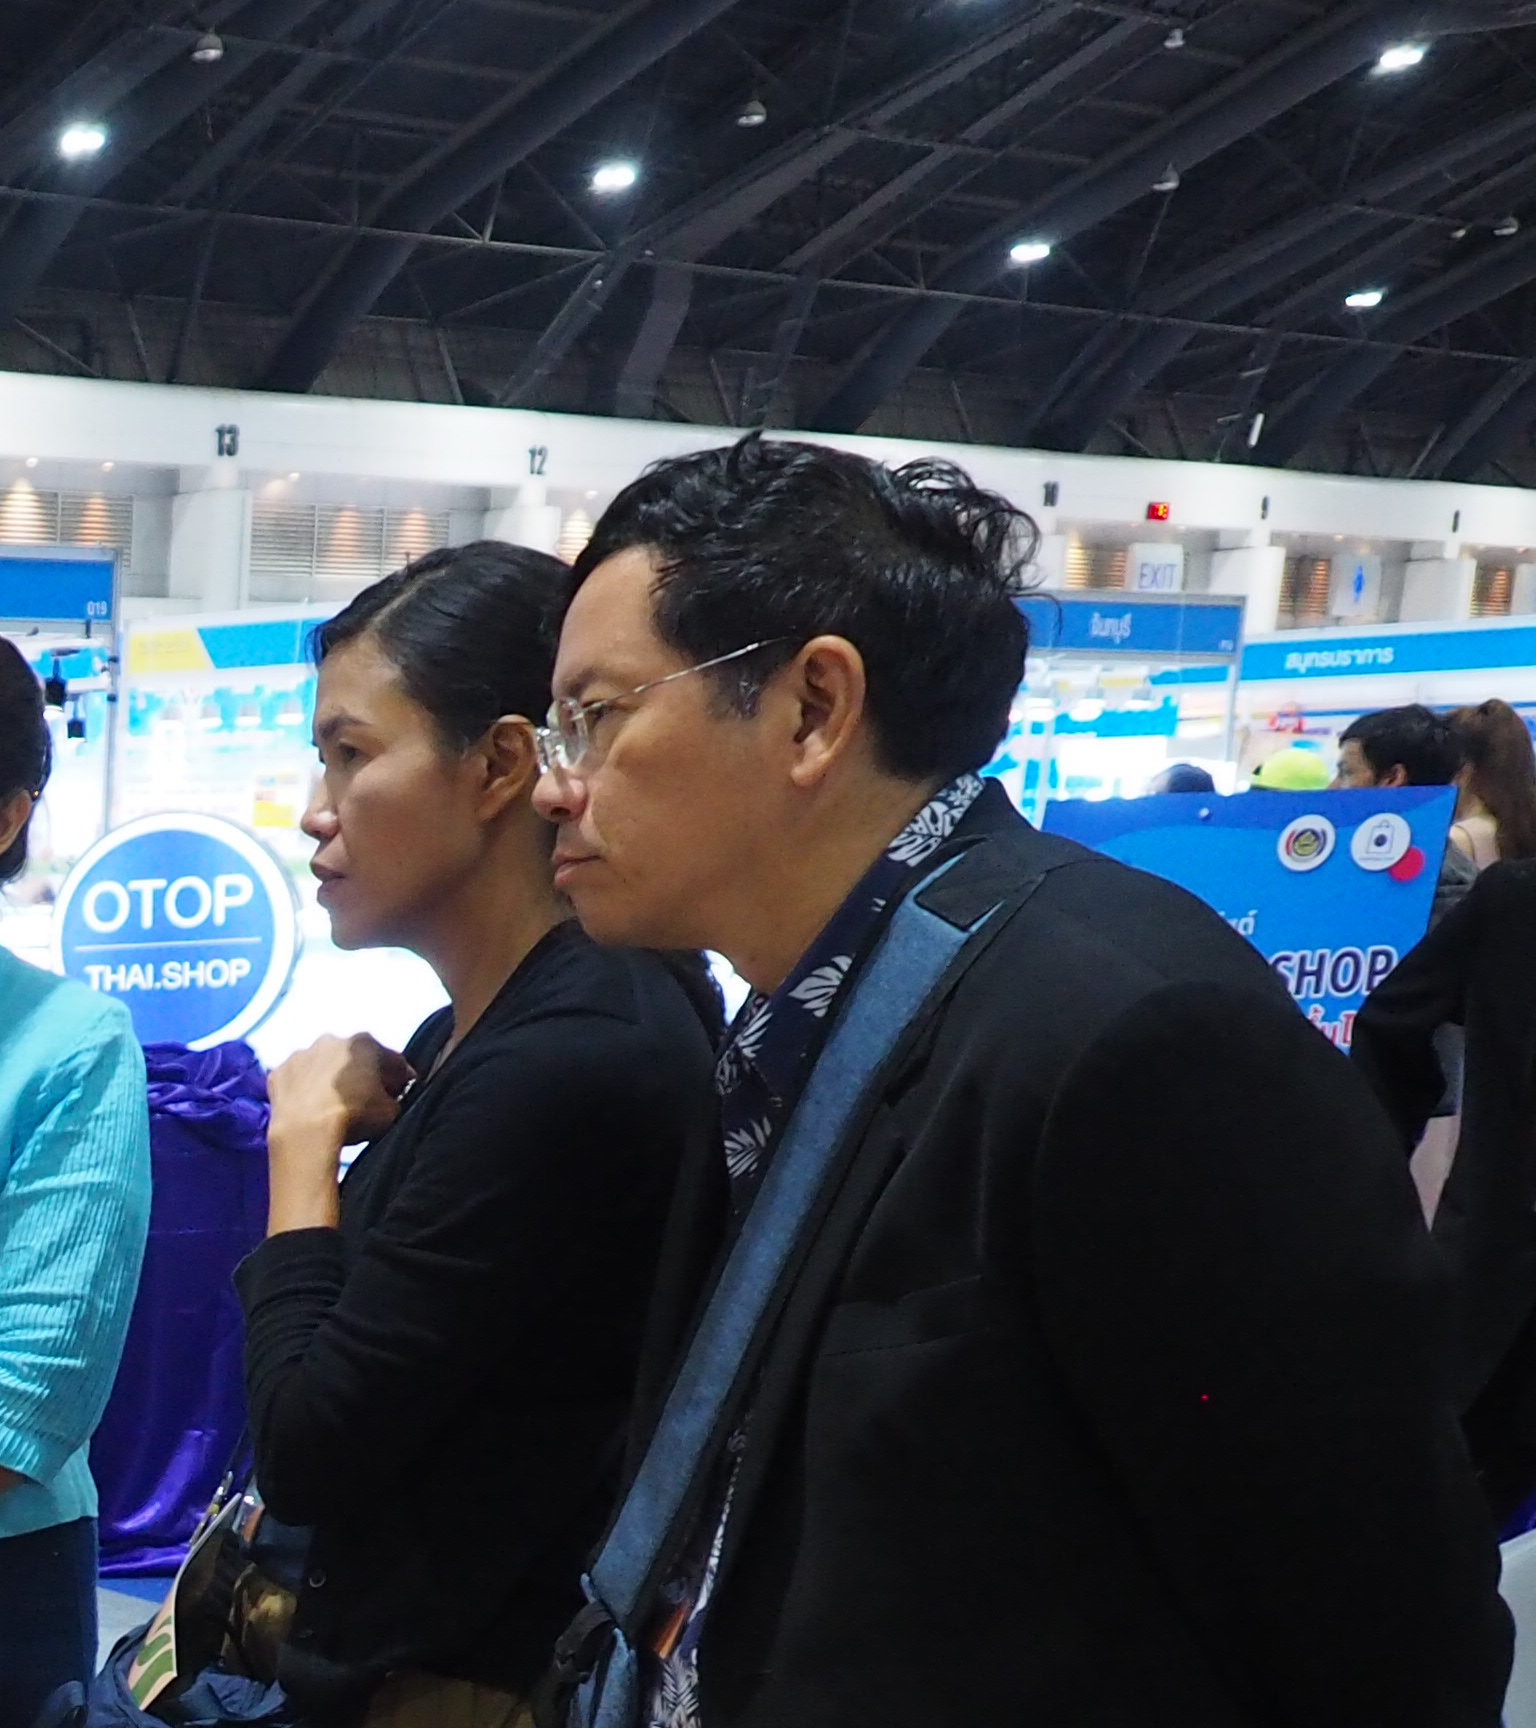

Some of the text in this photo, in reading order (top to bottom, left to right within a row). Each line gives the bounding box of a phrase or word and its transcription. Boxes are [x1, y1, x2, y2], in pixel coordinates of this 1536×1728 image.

[216, 424, 240, 456] 13
[529, 446, 548, 475] 12
[1139, 562, 1177, 588] EXIT
[83, 873, 254, 934] OTOP
[83, 957, 252, 992] THAI.SHOP
